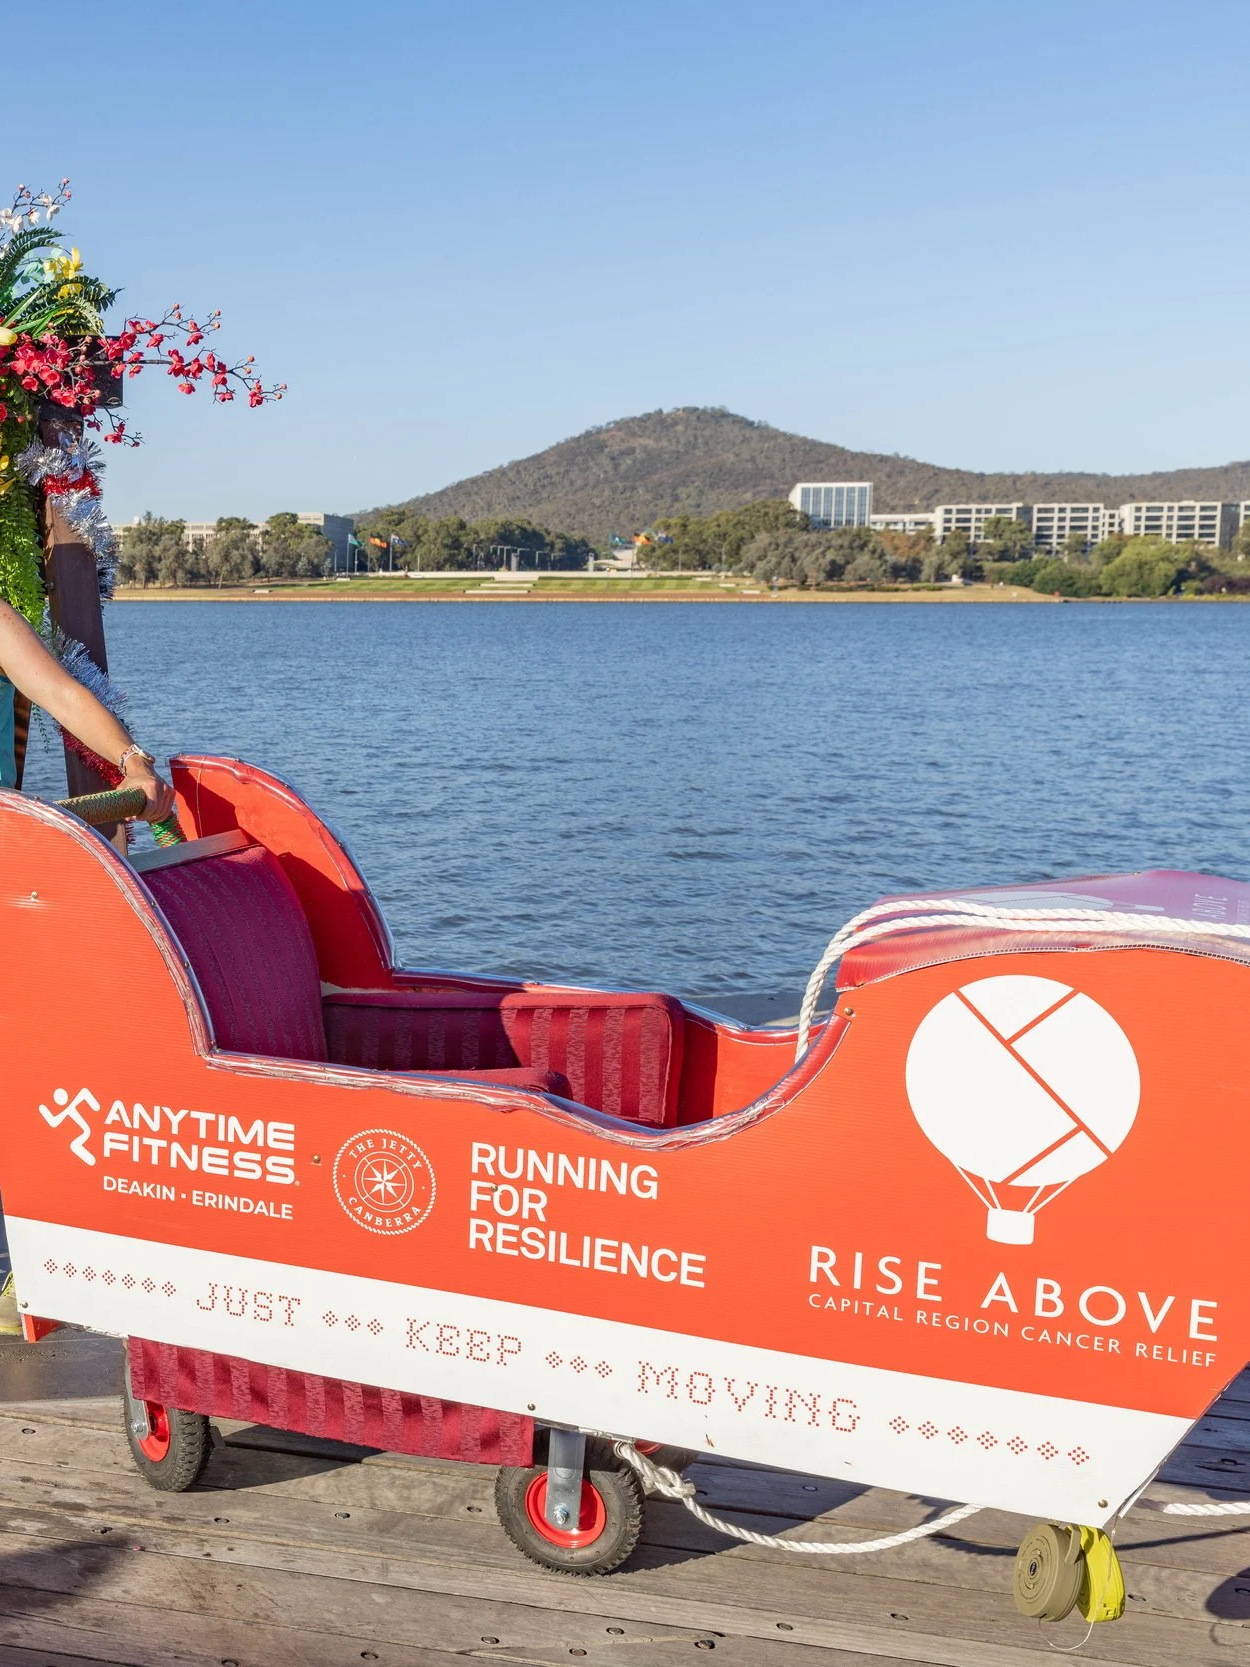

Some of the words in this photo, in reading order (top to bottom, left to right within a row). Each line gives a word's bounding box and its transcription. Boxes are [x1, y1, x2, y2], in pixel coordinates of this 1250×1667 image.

[104, 1099, 295, 1151] ANYTIME
[103, 1131, 296, 1185] FITNESS
[348, 1138, 375, 1159] THE
[381, 1138, 423, 1169] JETTY
[471, 1141, 658, 1200] RUNNING
[103, 1175, 175, 1201] DEAKIN
[191, 1189, 293, 1220] ERINDALE
[348, 1196, 421, 1228] CANBERRA
[470, 1179, 548, 1222] FOR
[468, 1217, 707, 1288] RESILIENCE
[809, 1245, 943, 1302] RISE
[980, 1271, 1218, 1342] ABOVE
[808, 1293, 904, 1321] CAPITAL
[916, 1310, 1009, 1338] REGION
[1021, 1326, 1121, 1354] CANCER
[1135, 1342, 1217, 1367] RELIEF
[196, 1283, 301, 1327] JUST
[405, 1317, 522, 1366] KEEP
[637, 1361, 861, 1432] MOVING
